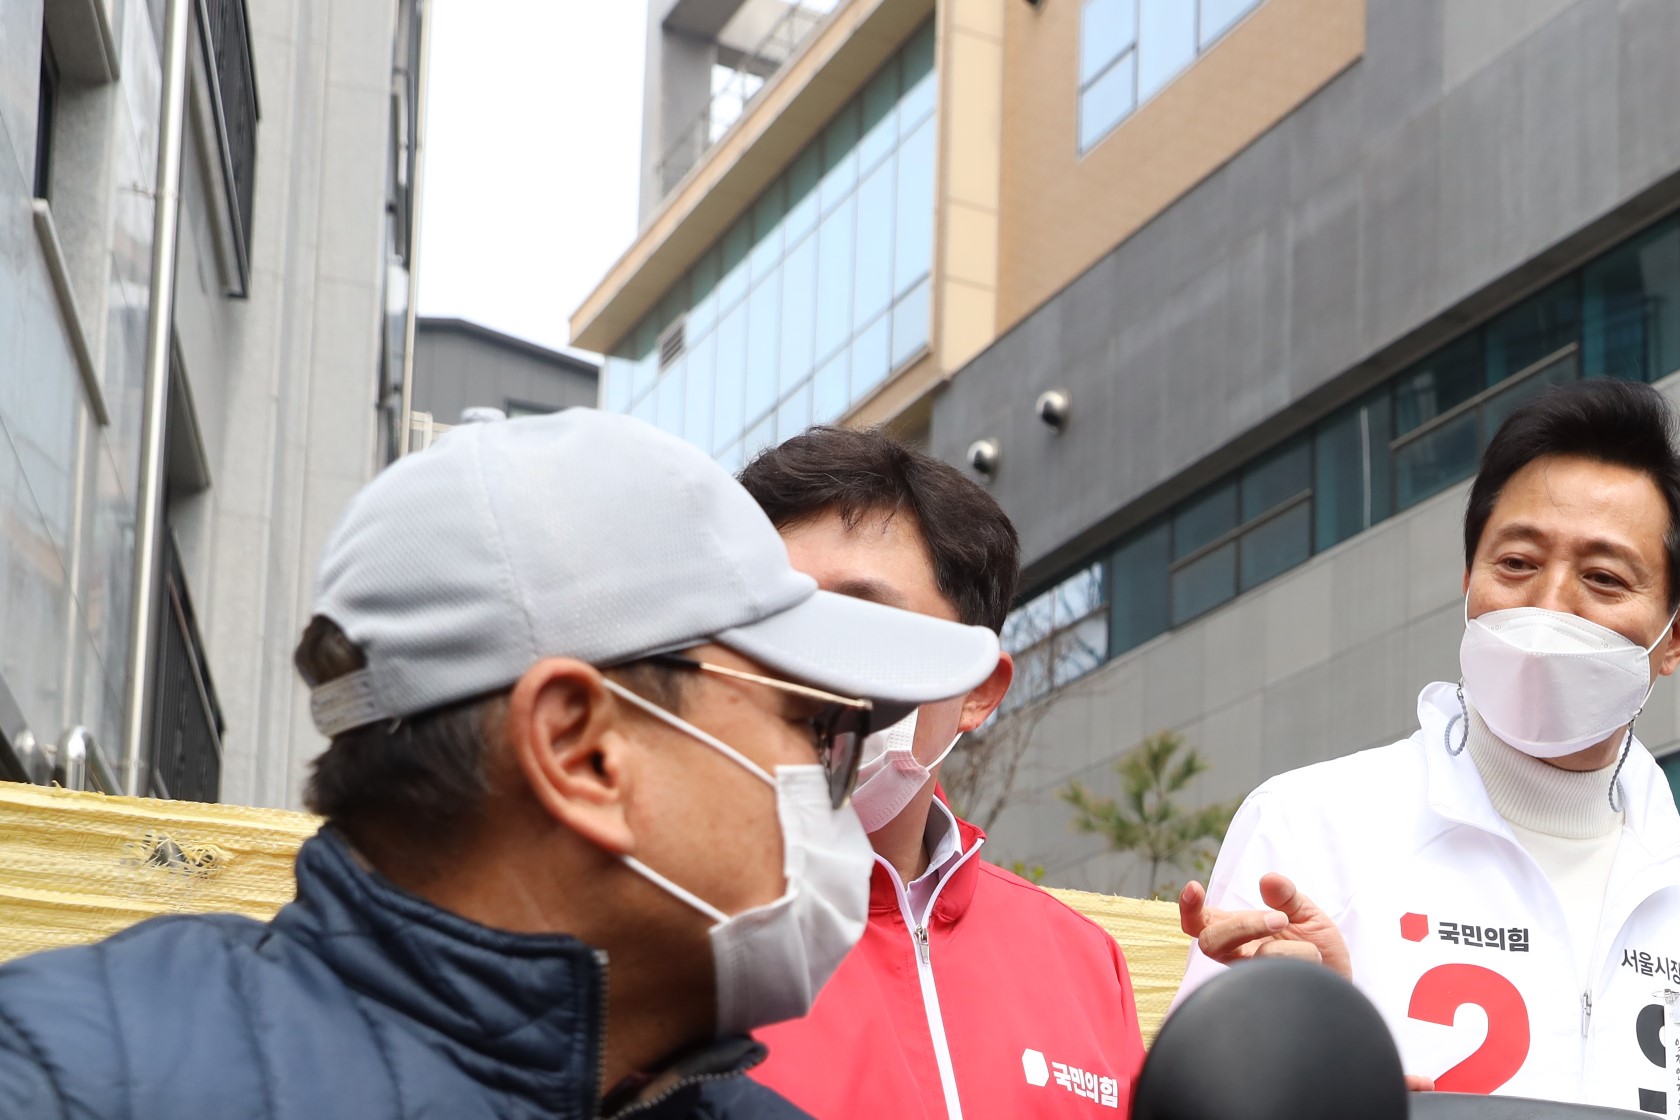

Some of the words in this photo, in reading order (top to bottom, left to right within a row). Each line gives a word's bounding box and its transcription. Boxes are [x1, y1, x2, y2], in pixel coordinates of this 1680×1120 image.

[1438, 921, 1530, 952] 국민의힘
[1407, 963, 1530, 1096] 2
[1052, 1061, 1118, 1108] 국민의힘
